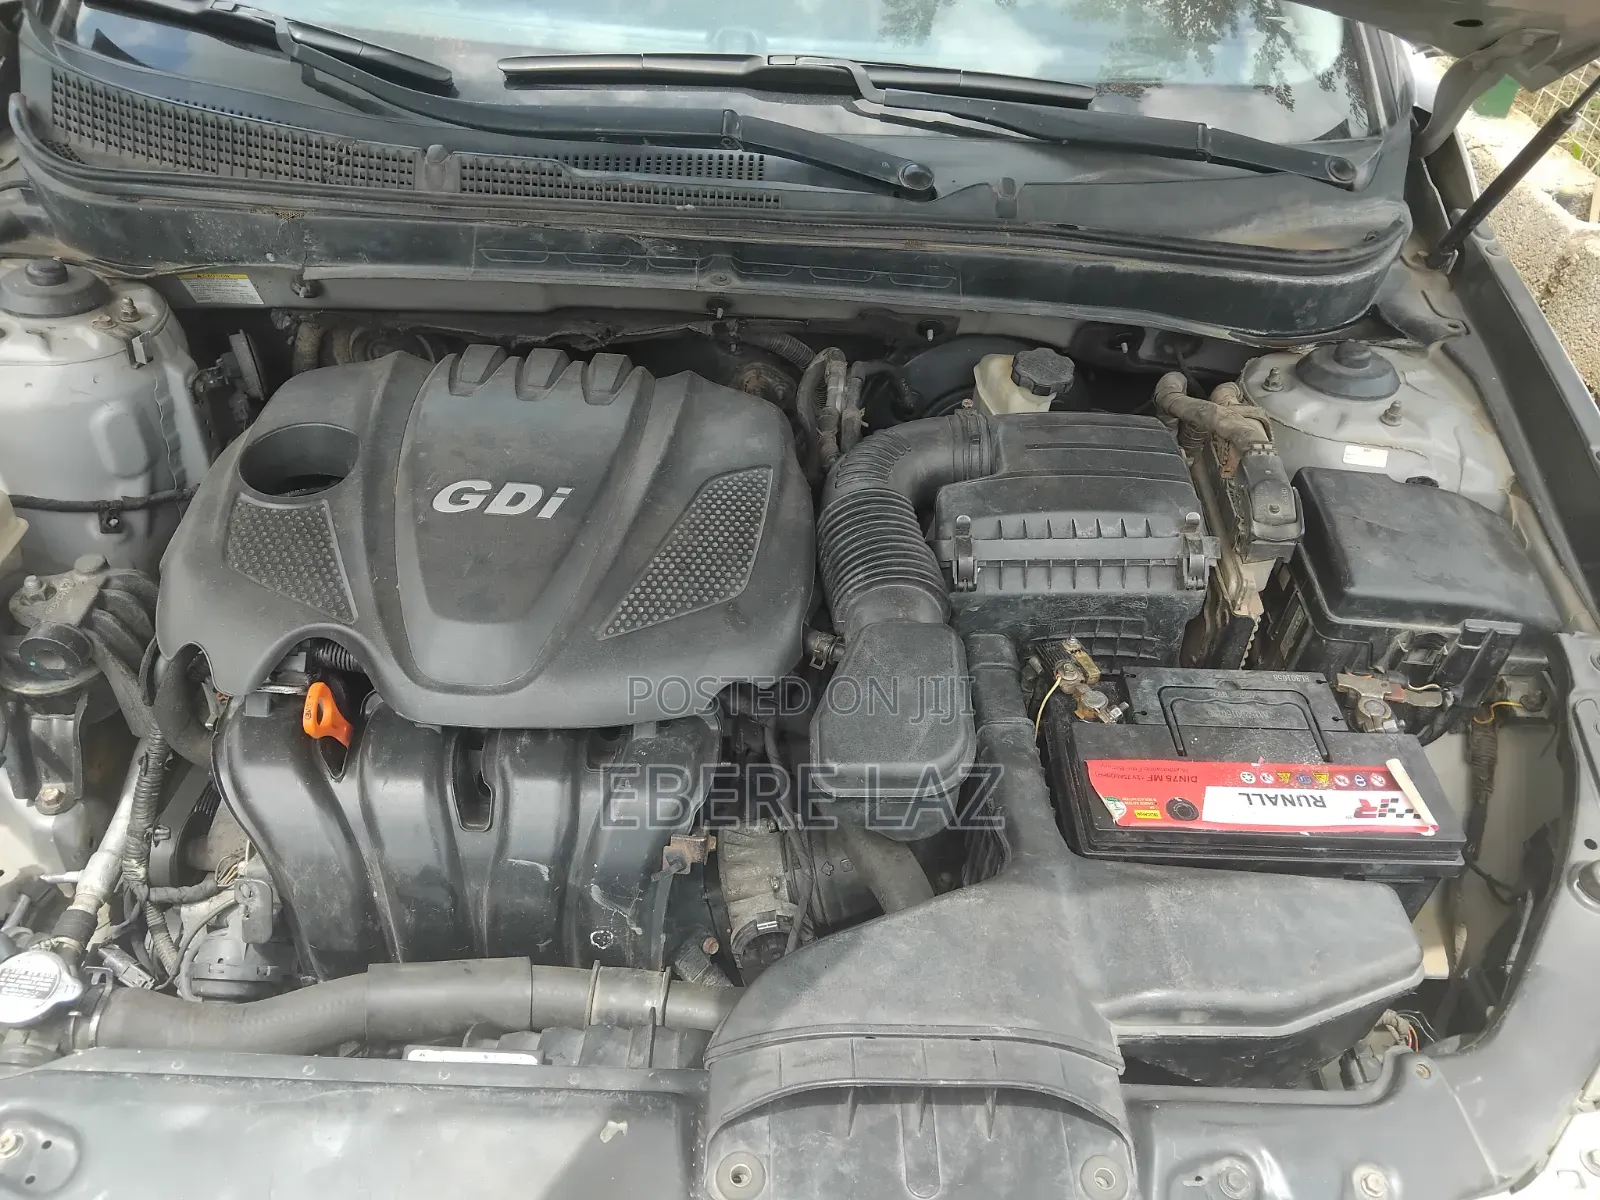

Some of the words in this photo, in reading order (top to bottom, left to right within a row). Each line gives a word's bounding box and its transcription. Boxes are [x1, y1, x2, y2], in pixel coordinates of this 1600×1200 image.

[432, 480, 575, 519] GDi
[1147, 774, 1163, 782] MF
[1165, 774, 1198, 783] DIN75
[1238, 792, 1327, 808] RUNALL
